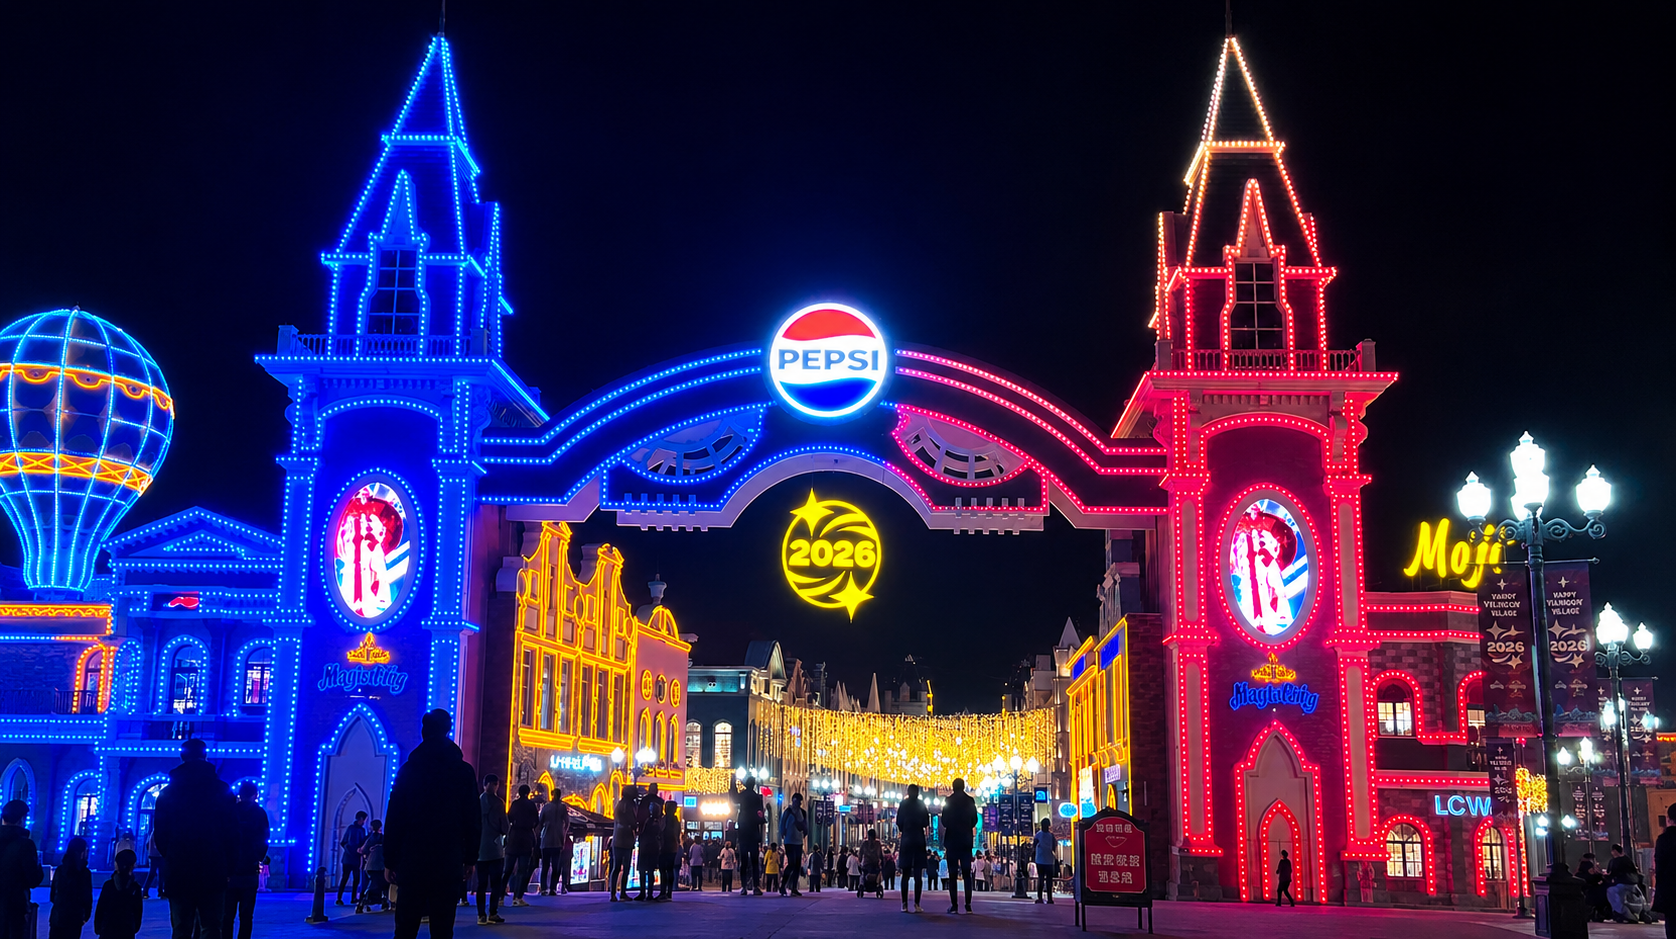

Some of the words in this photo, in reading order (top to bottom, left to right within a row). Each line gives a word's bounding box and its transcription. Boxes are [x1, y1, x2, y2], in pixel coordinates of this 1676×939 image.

[778, 349, 878, 371] PEPSI
[788, 539, 876, 566] 2026
[1487, 641, 1524, 652] 2026
[1550, 640, 1586, 651] 2026
[1434, 795, 1492, 816] LCW
